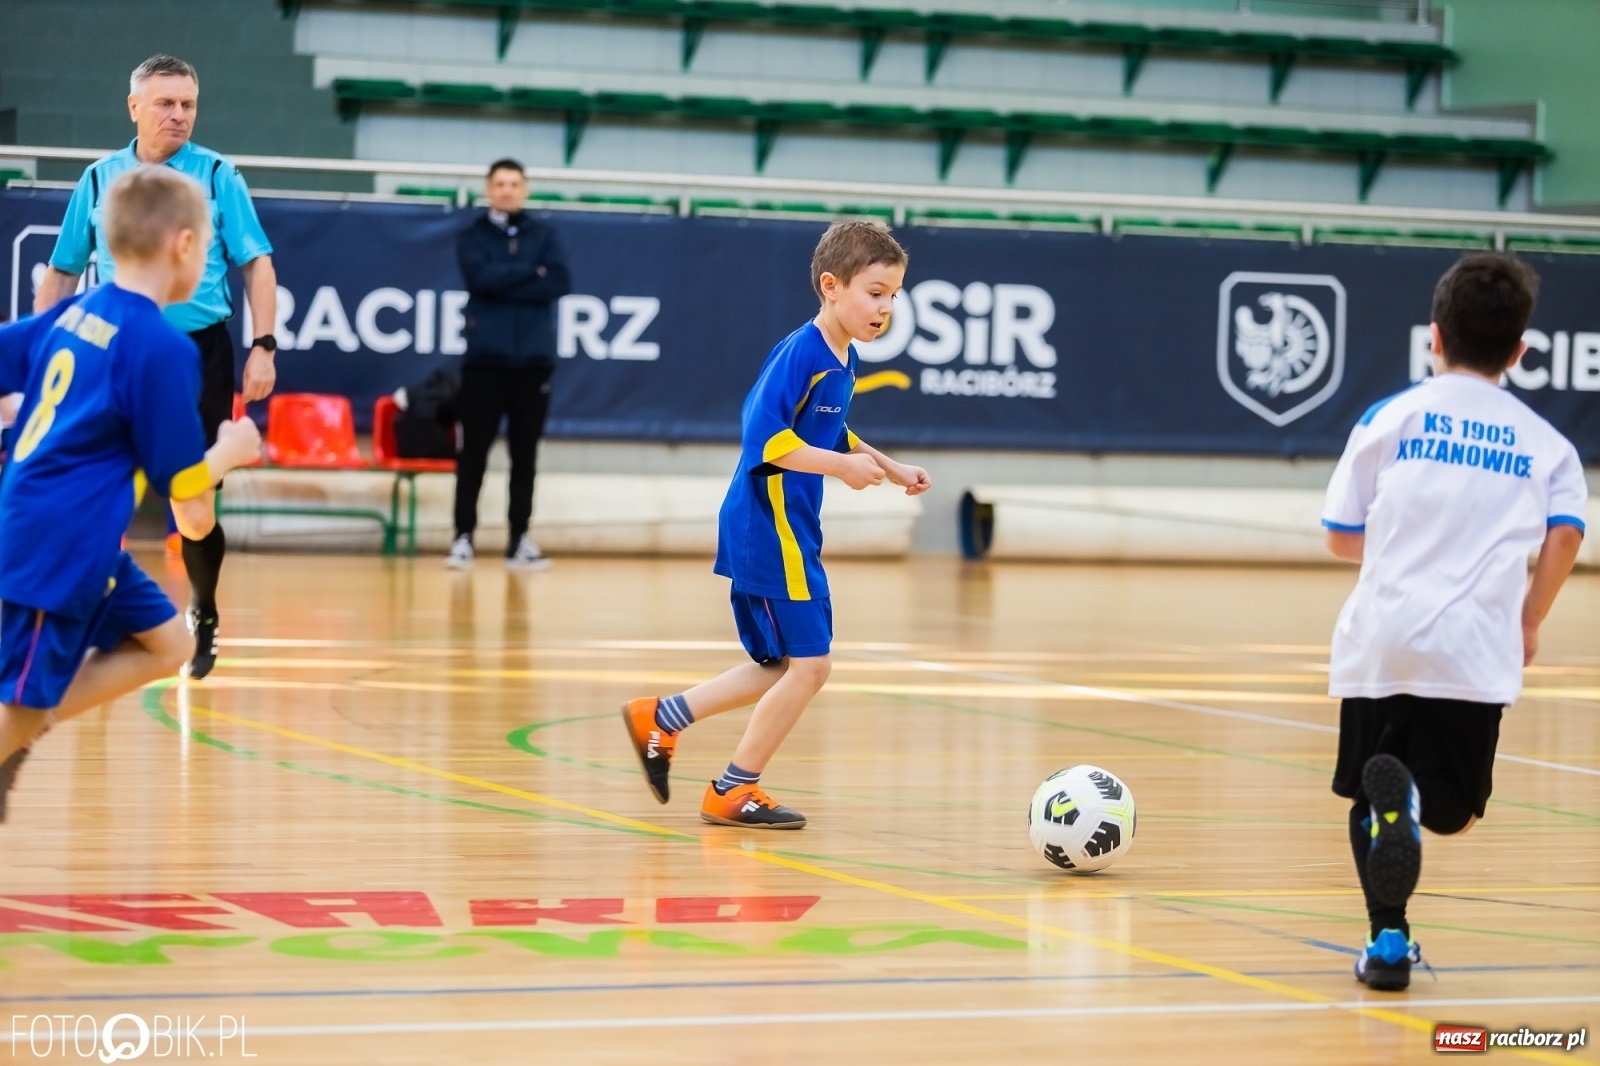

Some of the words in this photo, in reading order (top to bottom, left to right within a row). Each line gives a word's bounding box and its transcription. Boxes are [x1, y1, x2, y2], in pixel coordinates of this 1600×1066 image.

[242, 284, 660, 361] RACIBRZ
[919, 364, 1057, 399] RACIBÓRZ
[13, 347, 76, 463] 8
[1424, 412, 1453, 435] KS
[1460, 419, 1516, 447] 1905
[647, 730, 661, 759] FILA
